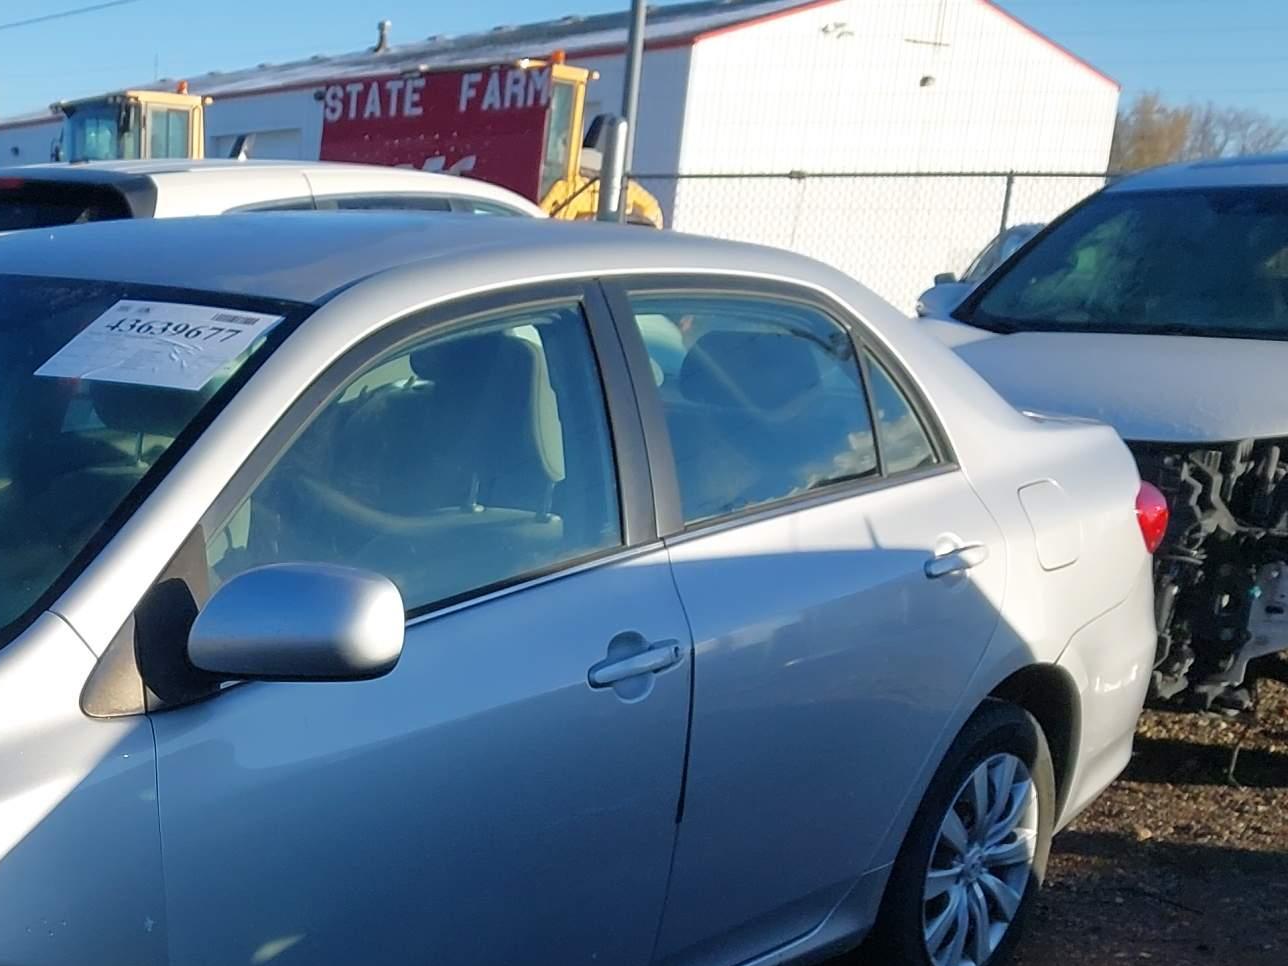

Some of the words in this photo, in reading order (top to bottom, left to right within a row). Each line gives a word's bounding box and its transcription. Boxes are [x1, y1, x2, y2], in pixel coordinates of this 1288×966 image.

[324, 76, 427, 122] STATE
[458, 66, 551, 113] FARM
[105, 317, 243, 343] 43639677
